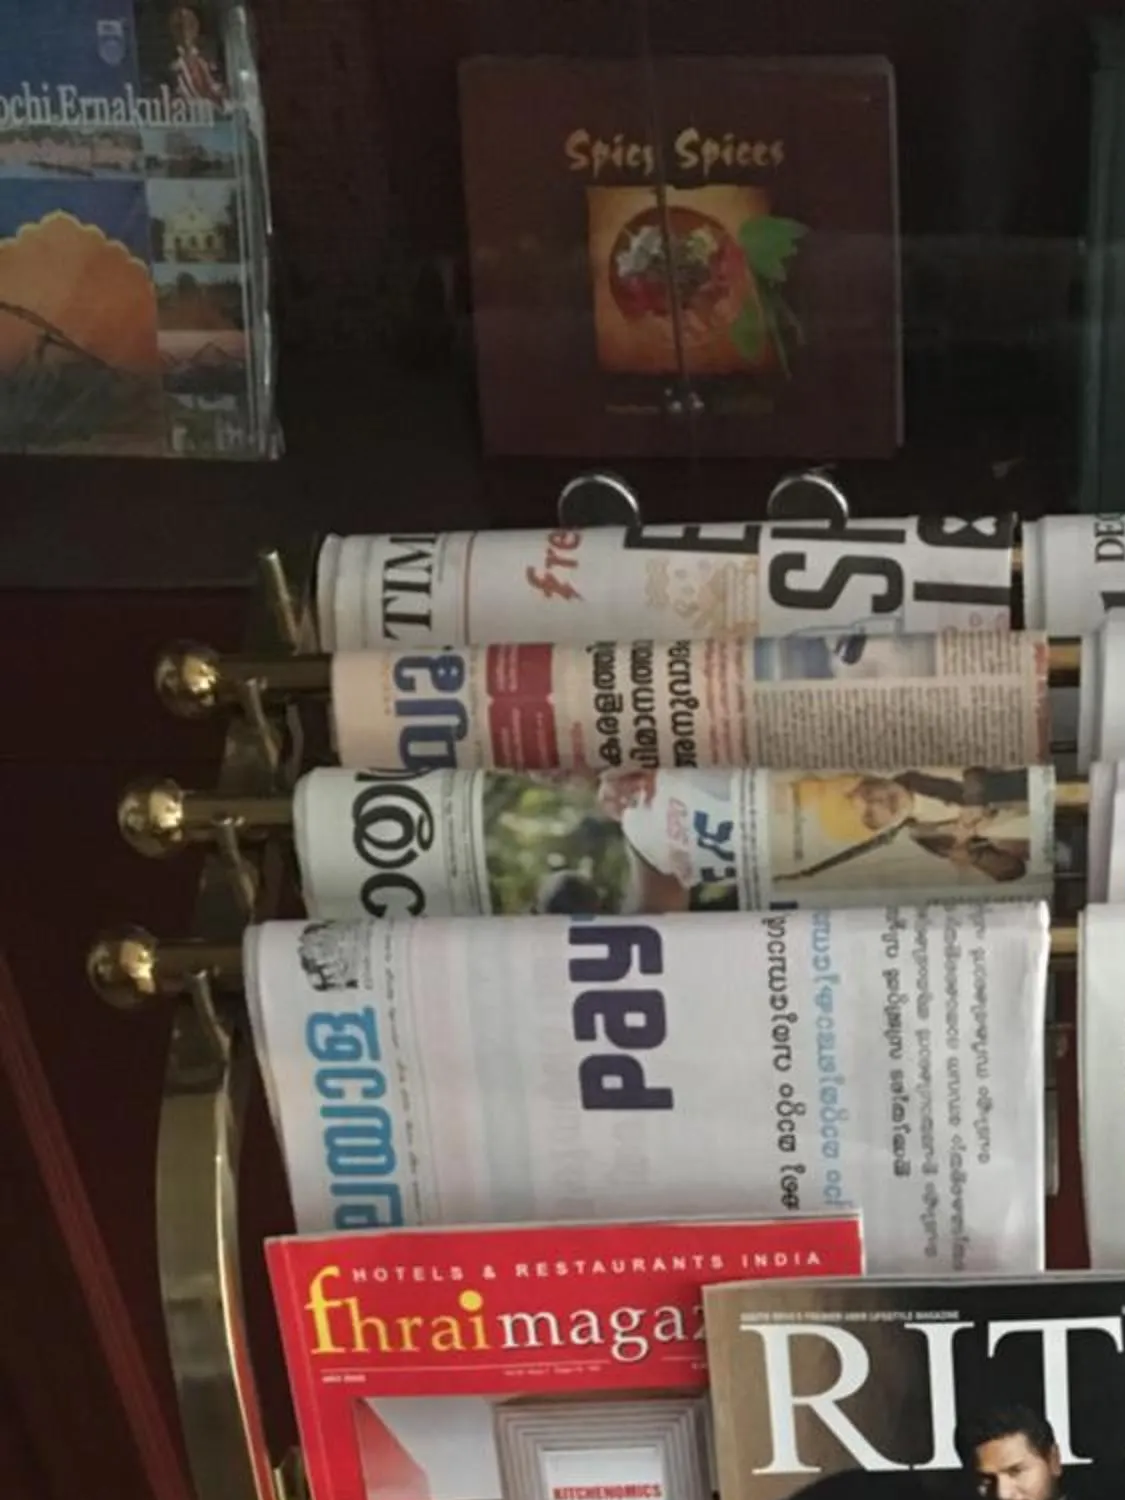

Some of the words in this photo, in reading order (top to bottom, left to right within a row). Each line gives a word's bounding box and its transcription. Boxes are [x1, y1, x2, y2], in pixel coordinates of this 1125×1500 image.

[0, 81, 51, 128] ochi
[675, 127, 785, 178] Spices
[382, 535, 436, 641] TIM
[352, 1265, 463, 1283] HOTELS
[482, 1266, 497, 1280] &
[515, 1252, 725, 1278] RESTAURANTS
[741, 1250, 822, 1268] INDIA
